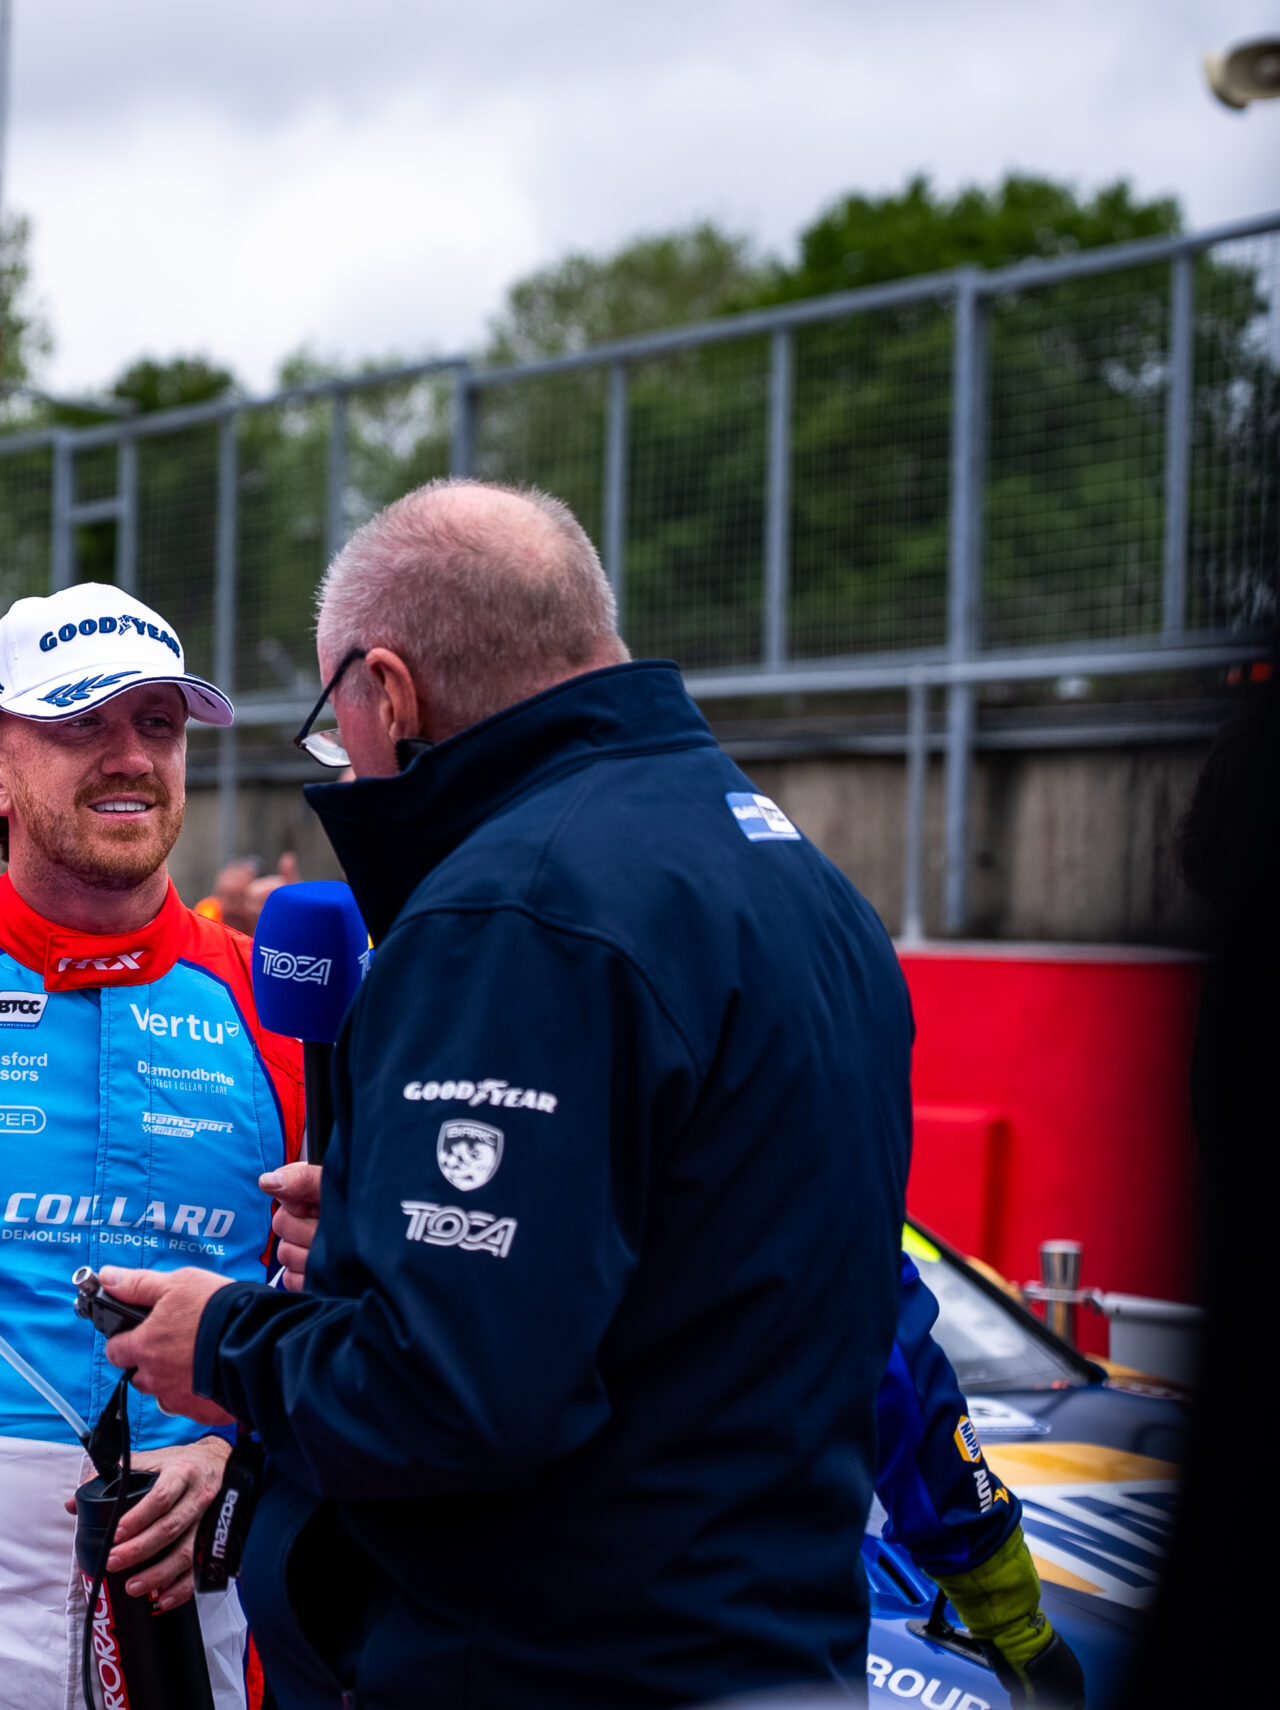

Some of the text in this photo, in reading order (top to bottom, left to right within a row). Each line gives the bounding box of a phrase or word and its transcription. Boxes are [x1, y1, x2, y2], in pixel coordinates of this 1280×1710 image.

[39, 615, 181, 658] GOODYEAR
[259, 945, 332, 986] TOCA
[129, 1003, 224, 1045] Vertu
[137, 1060, 235, 1086] Diamondbrite
[180, 1082, 203, 1092] CLEAN
[210, 1085, 228, 1095] CARE
[403, 1078, 558, 1113] GOODYEAR
[3, 1192, 236, 1238] COLLARD
[400, 1200, 518, 1258] TOCA
[1, 1229, 226, 1256] DEMOLISH DISPOSE RECYCLE
[960, 1422, 979, 1459] NAPA
